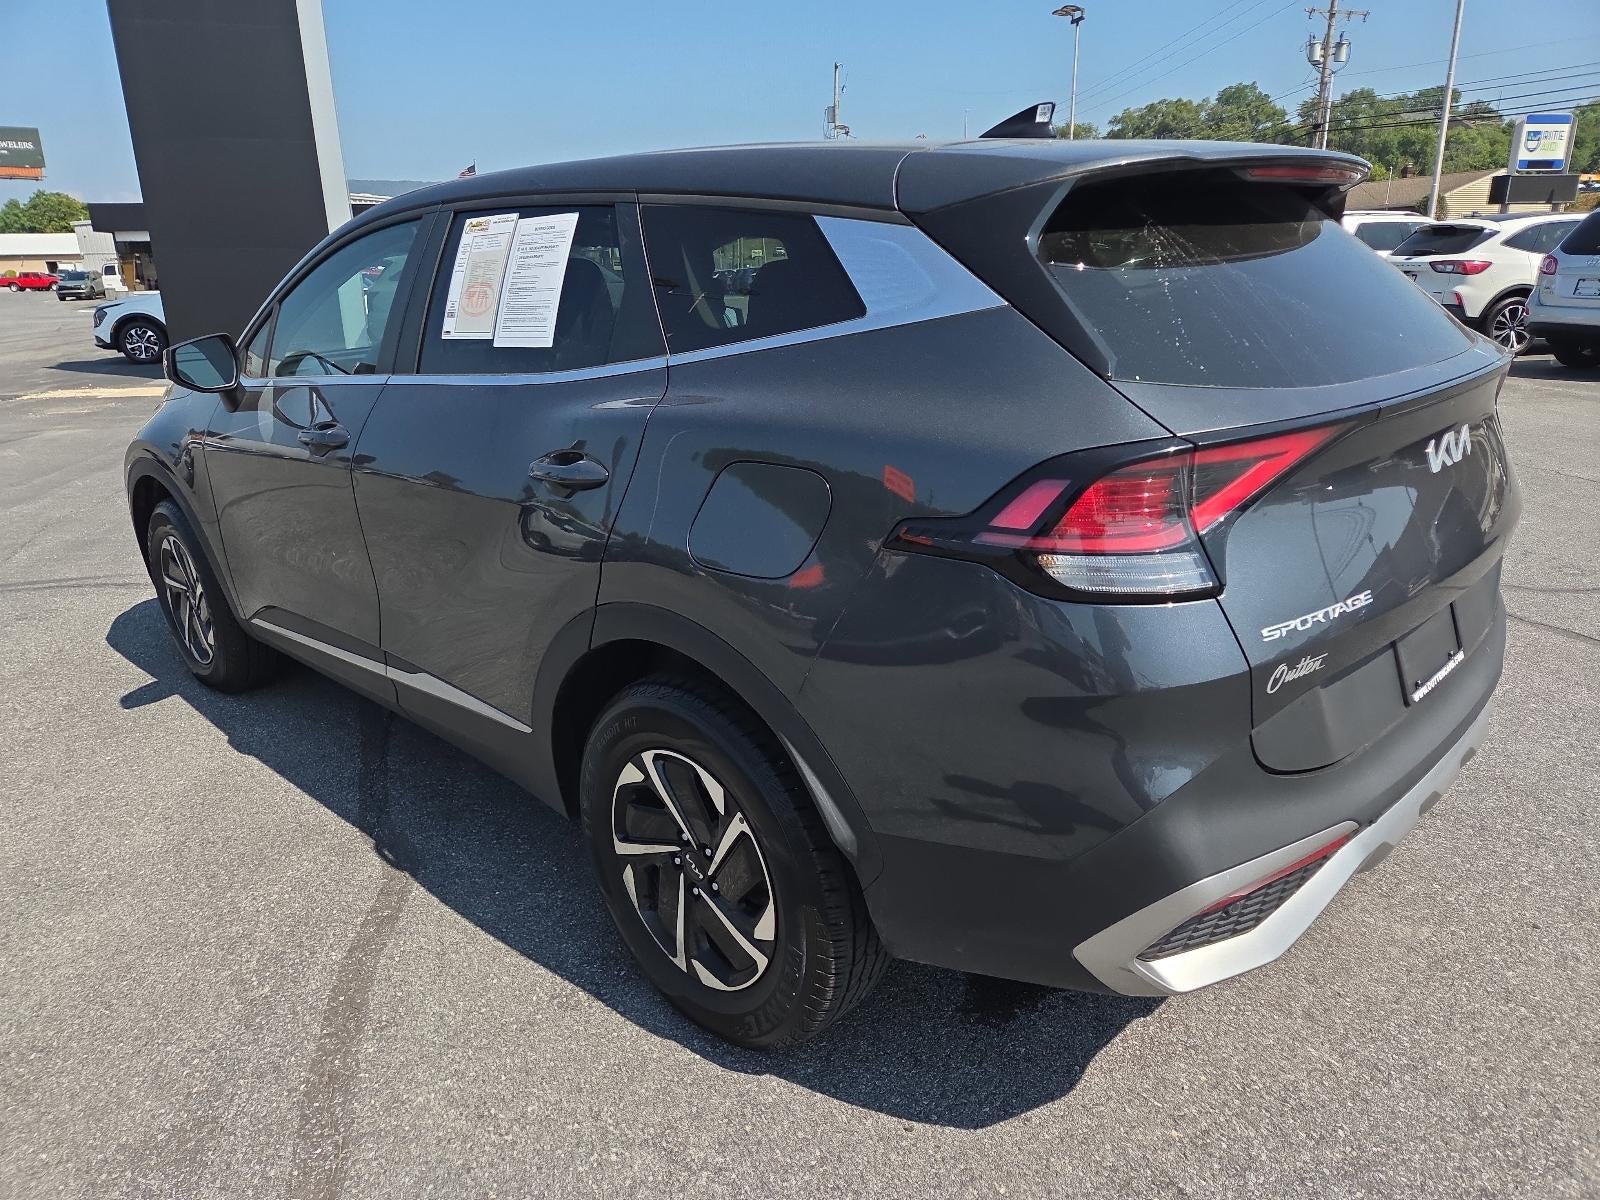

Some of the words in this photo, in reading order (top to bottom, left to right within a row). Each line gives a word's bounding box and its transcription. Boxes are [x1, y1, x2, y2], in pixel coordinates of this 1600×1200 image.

[1542, 130, 1566, 141] RITE
[1425, 423, 1471, 473] KIA
[1260, 589, 1374, 642] SPORTAGE
[1266, 652, 1329, 694] Outten
